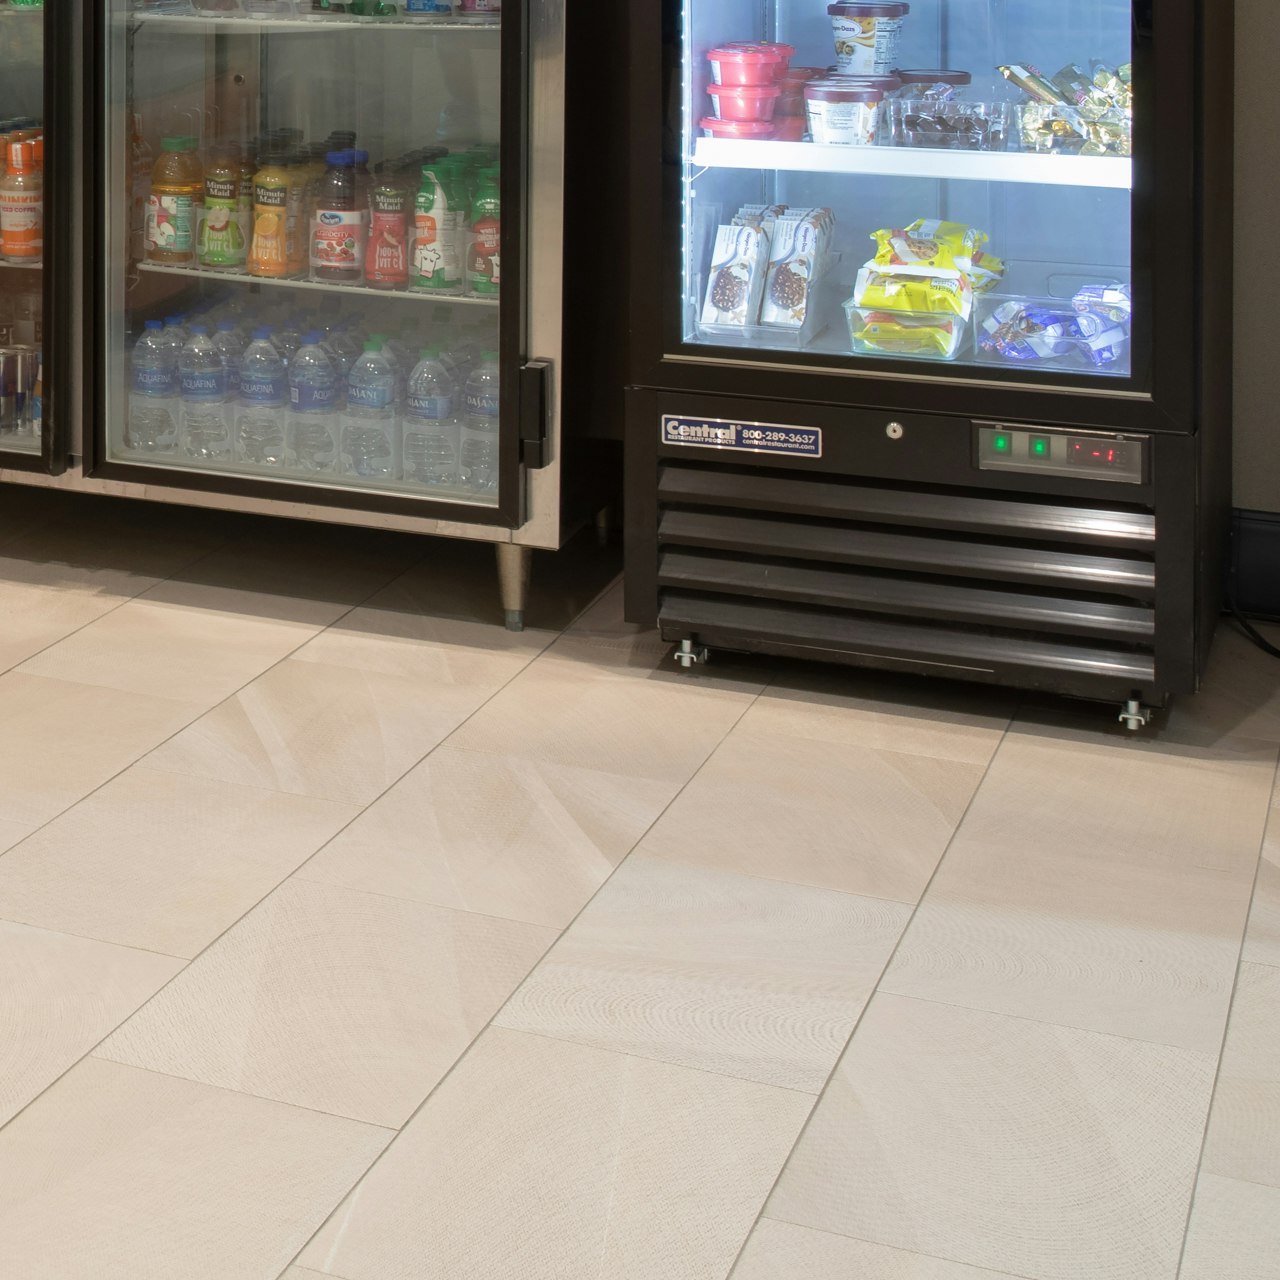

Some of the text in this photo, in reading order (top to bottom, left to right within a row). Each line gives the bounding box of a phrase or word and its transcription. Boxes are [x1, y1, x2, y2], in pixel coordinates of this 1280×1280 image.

[207, 180, 234, 190] Minute
[209, 188, 230, 197] Maid
[256, 187, 285, 198] Minute
[259, 196, 281, 204] Maid
[375, 194, 404, 203] Minute
[379, 201, 400, 210] Maid
[183, 378, 217, 389] AQUAFINA
[666, 420, 736, 439] Central
[667, 434, 736, 445] RESTAURANT PRODUCTS
[742, 429, 815, 444] 800-289-3637
[742, 438, 815, 451] centralrestaurant.com
